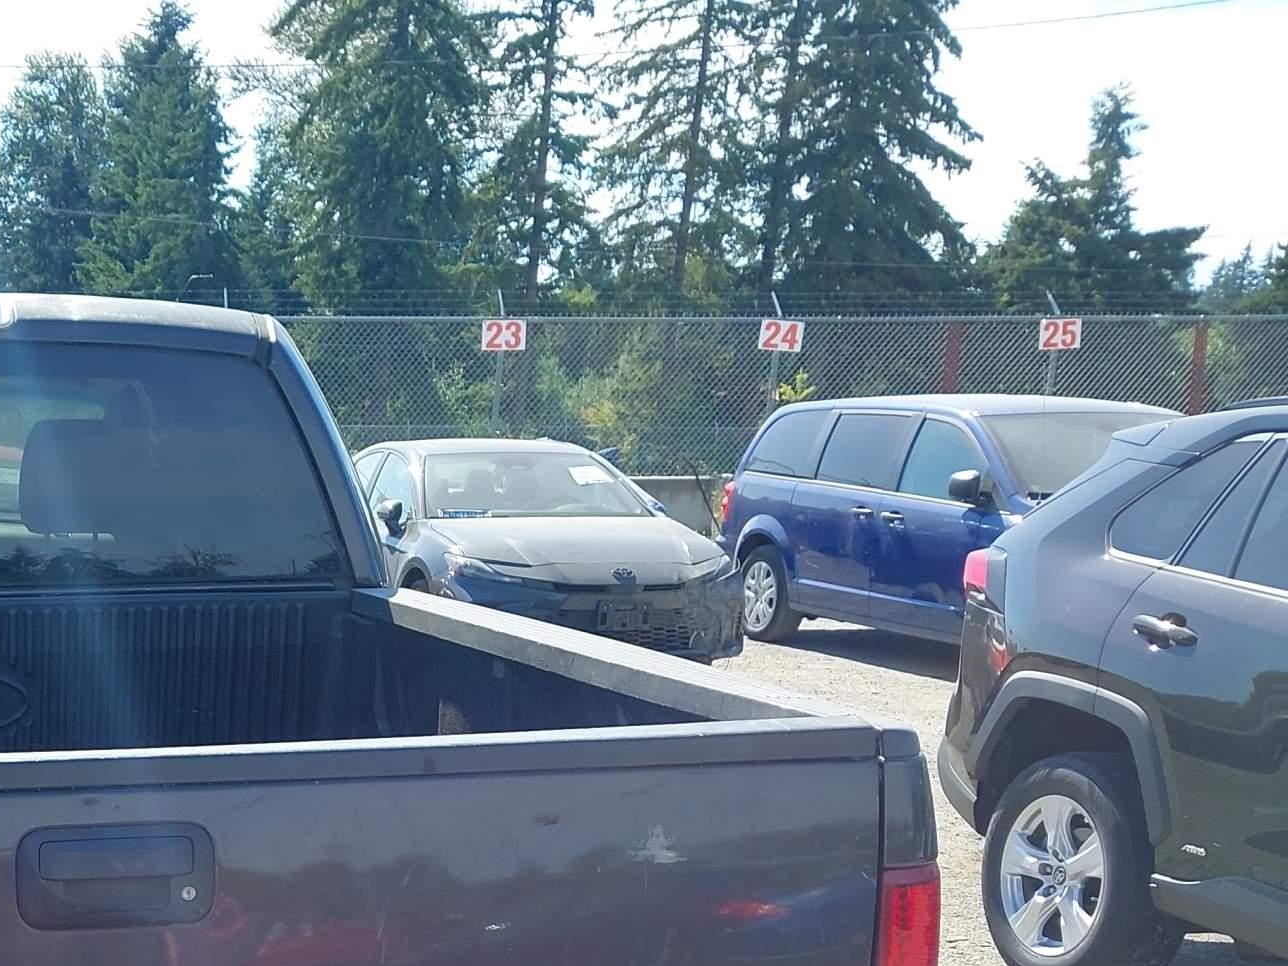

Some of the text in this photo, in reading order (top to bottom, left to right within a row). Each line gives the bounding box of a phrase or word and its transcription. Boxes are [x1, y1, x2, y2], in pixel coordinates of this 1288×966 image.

[486, 321, 522, 348] 23
[762, 321, 798, 349] 24
[1043, 320, 1077, 348] 25
